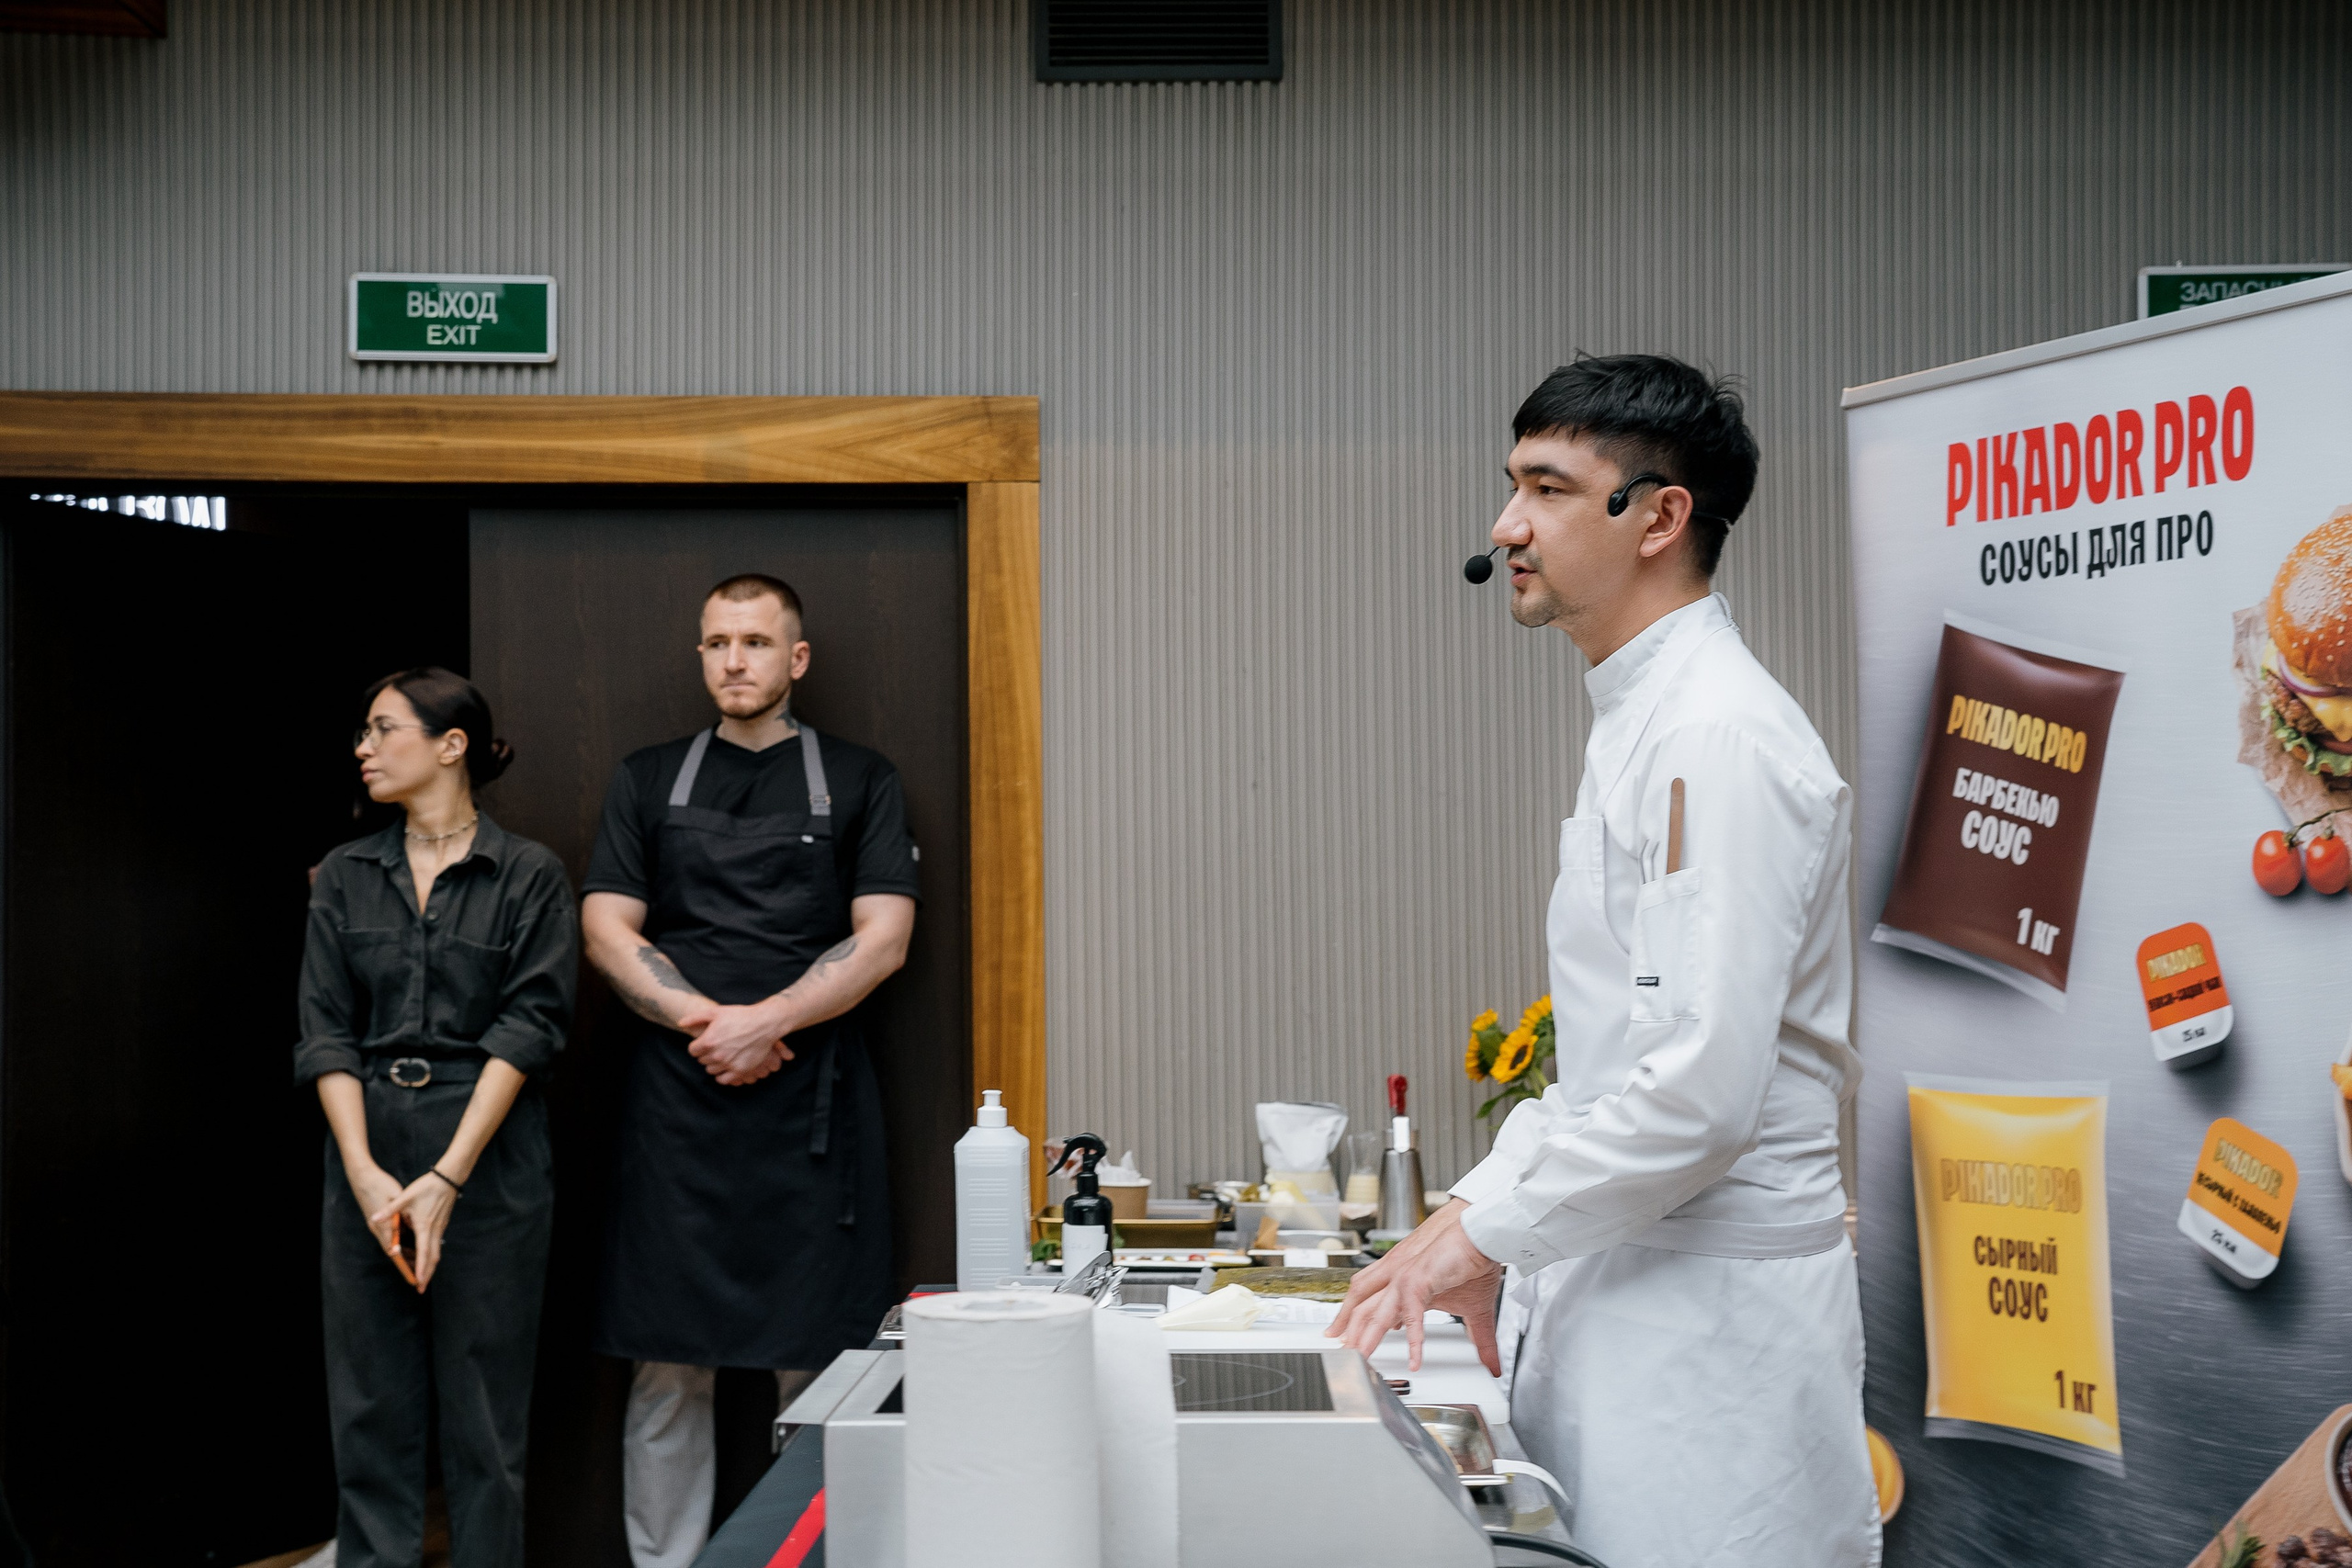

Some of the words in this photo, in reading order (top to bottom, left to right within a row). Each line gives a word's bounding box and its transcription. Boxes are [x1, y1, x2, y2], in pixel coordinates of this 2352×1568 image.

[407, 290, 498, 324] ВЫХОД
[2180, 277, 2308, 301] ЗАПАС
[426, 323, 481, 345] EXIT
[1946, 409, 2144, 527] PIKADOR
[2154, 386, 2254, 493] PRO
[1981, 531, 2078, 586] СОУСЫ
[2086, 520, 2146, 580] ДЛЯ
[2156, 510, 2214, 562] ПРО
[1961, 809, 2032, 866] СОУС
[2017, 908, 2033, 945] 1
[1973, 1235, 2058, 1275] СЫРНЫЙ
[1988, 1276, 2048, 1323] СОУС
[2054, 1370, 2065, 1408] 1
